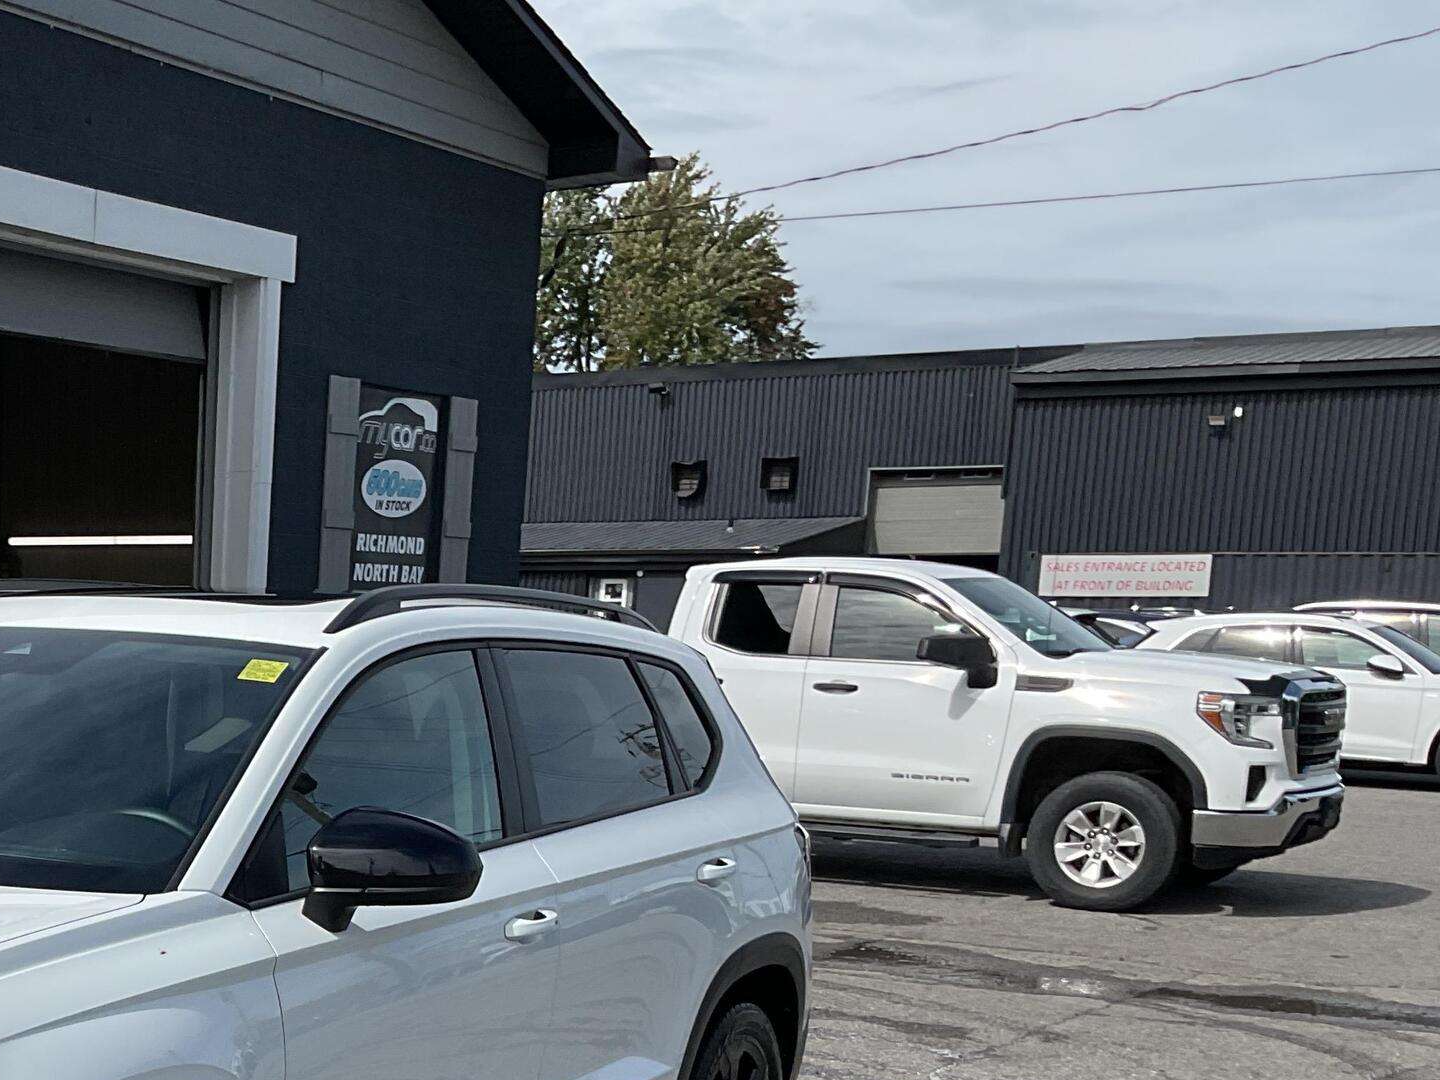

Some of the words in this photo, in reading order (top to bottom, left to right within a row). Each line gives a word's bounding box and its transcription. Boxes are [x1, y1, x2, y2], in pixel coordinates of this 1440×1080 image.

[375, 500, 385, 511] IN
[385, 500, 412, 512] STOCK
[356, 533, 425, 555] RICHMOND
[1047, 561, 1080, 573] SALES
[1083, 561, 1147, 573] ENTRANCE
[1150, 561, 1207, 573] LOCATED
[353, 562, 399, 583] NORTH
[400, 565, 425, 585] BAY
[1054, 580, 1070, 591] AT
[1073, 580, 1112, 591] FRONT
[1115, 580, 1130, 591] OF
[1135, 580, 1194, 591] BUILDING
